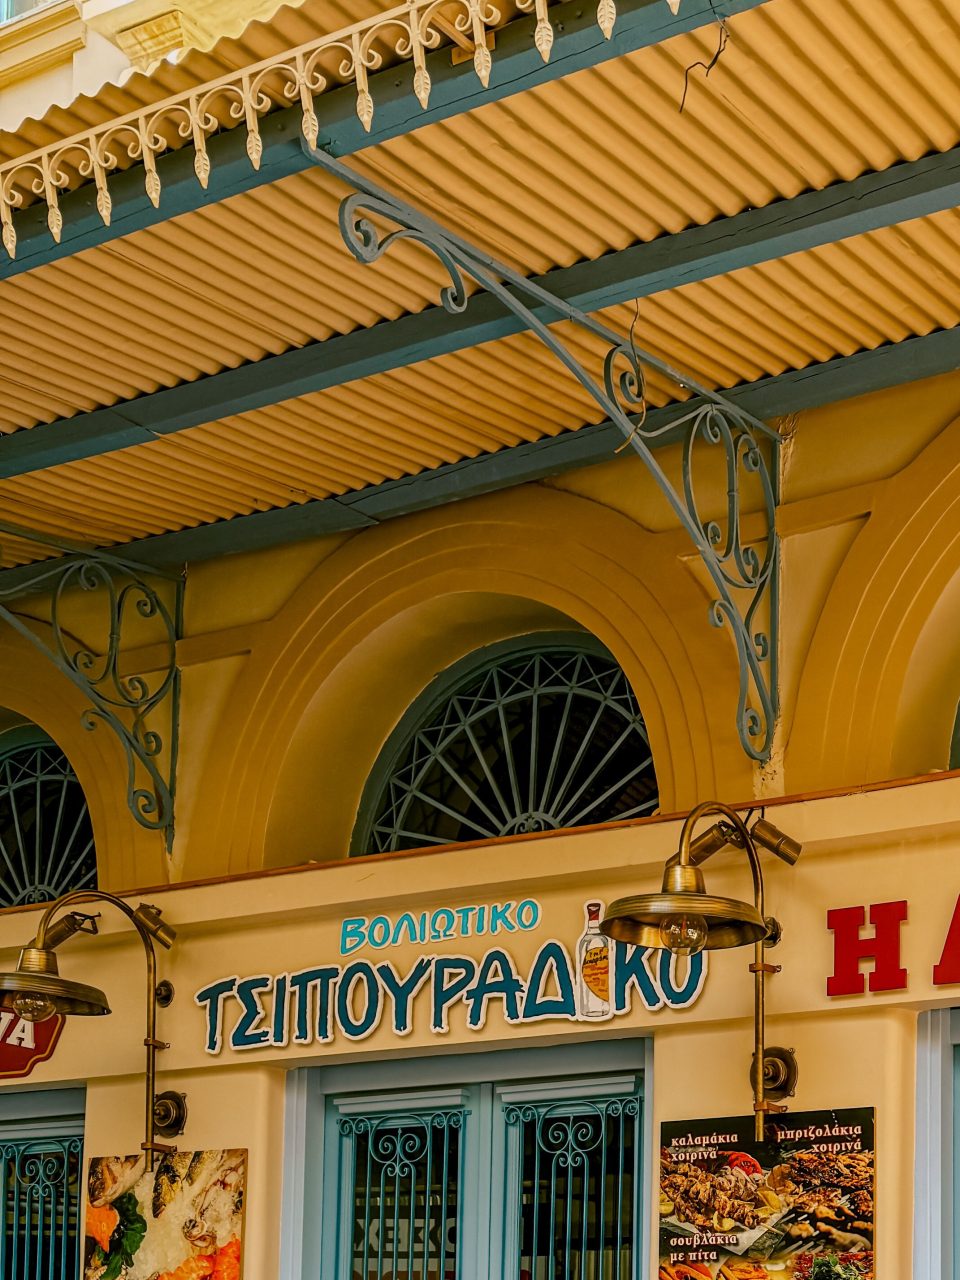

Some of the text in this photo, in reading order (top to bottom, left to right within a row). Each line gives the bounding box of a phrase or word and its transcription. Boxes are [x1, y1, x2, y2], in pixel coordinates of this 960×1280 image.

[341, 899, 541, 955] ΒΟΛΙΩΤΙΚΟ
[827, 900, 908, 997] Η
[671, 1133, 738, 1147] καλαμάκια
[777, 1125, 862, 1142] μπριζολάκια
[812, 1139, 862, 1154] χοιρινά
[671, 1148, 717, 1162] χοιρινά
[670, 1233, 737, 1249] σουβλάκια
[670, 1250, 717, 1264] με πίτα
